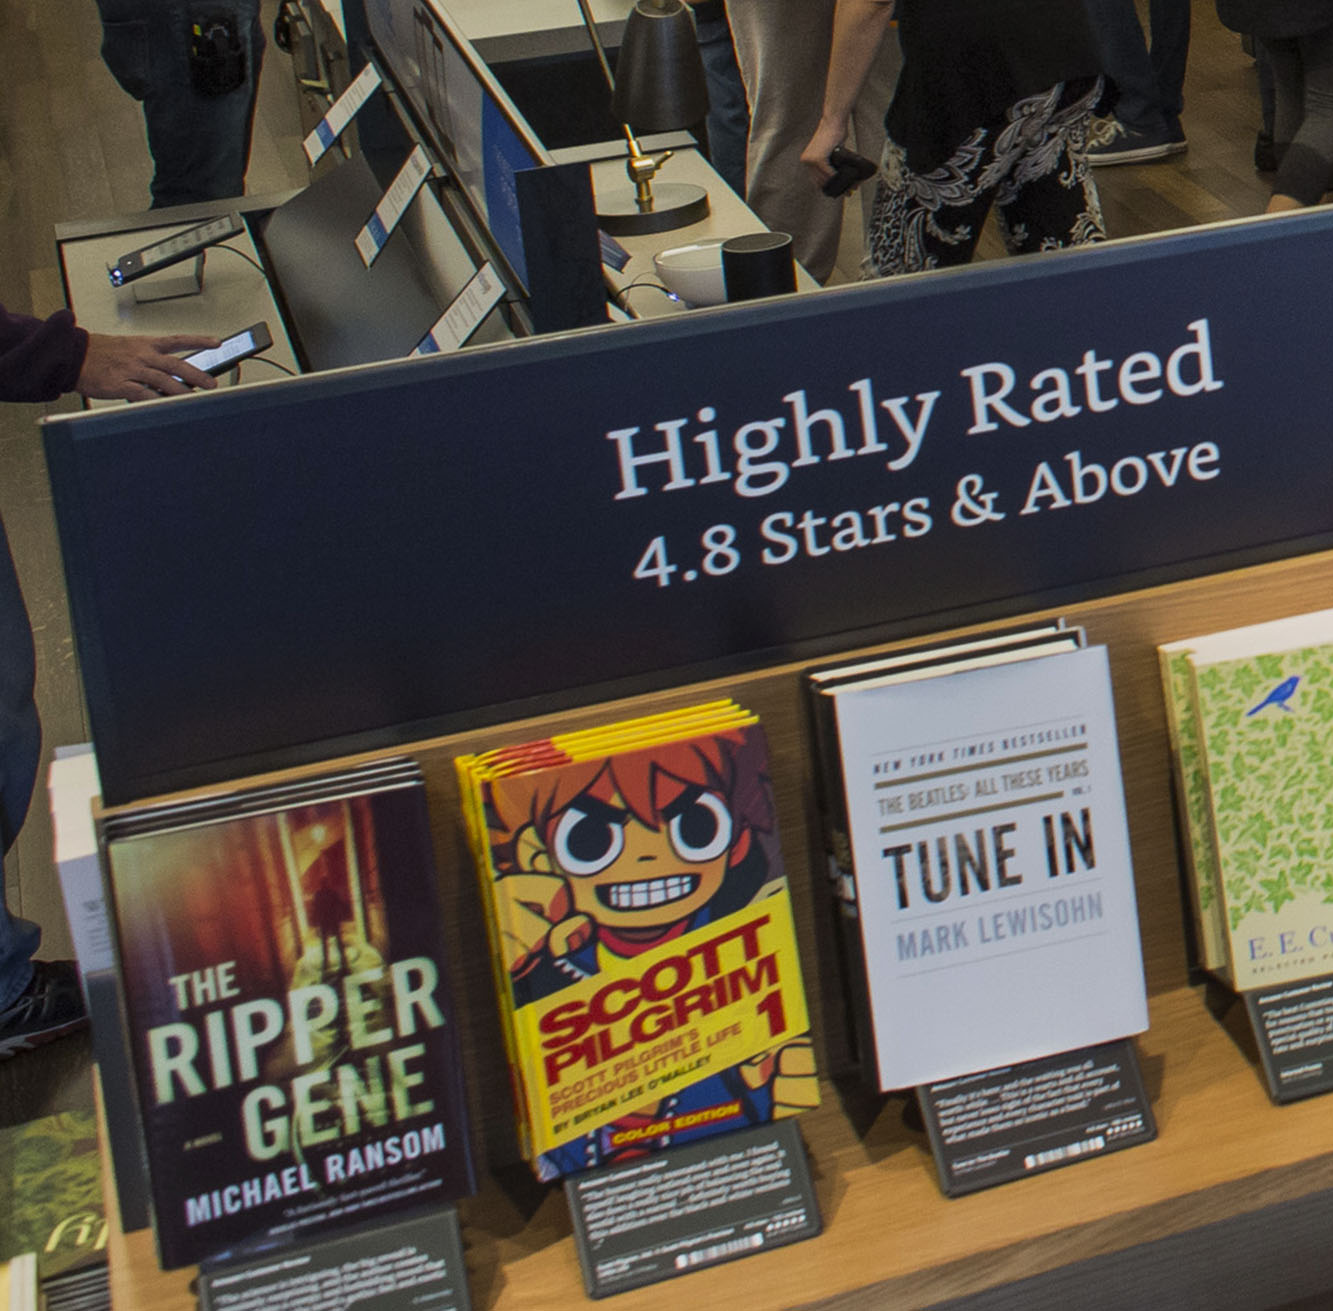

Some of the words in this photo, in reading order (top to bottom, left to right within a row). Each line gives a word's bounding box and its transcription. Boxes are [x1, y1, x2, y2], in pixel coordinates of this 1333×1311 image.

[606, 378, 941, 500] Highly
[961, 318, 1225, 436] Rated
[633, 523, 741, 588] 4.8
[760, 495, 933, 565] Stars
[951, 474, 1006, 528] &
[1019, 440, 1222, 517] Above
[882, 822, 1023, 910] TUNE
[1042, 806, 1096, 879] IN
[540, 913, 771, 1049] SCOTT
[896, 920, 969, 962] MARK
[978, 891, 1104, 945] LEWISOHN
[147, 956, 446, 1108] RIPPER
[169, 961, 240, 1011] THE
[543, 949, 781, 1087] PILGRIM
[756, 989, 787, 1038] 1
[241, 1043, 435, 1161] GENE
[185, 1162, 317, 1227] MICHAEL
[324, 1123, 446, 1183] RANSOM
